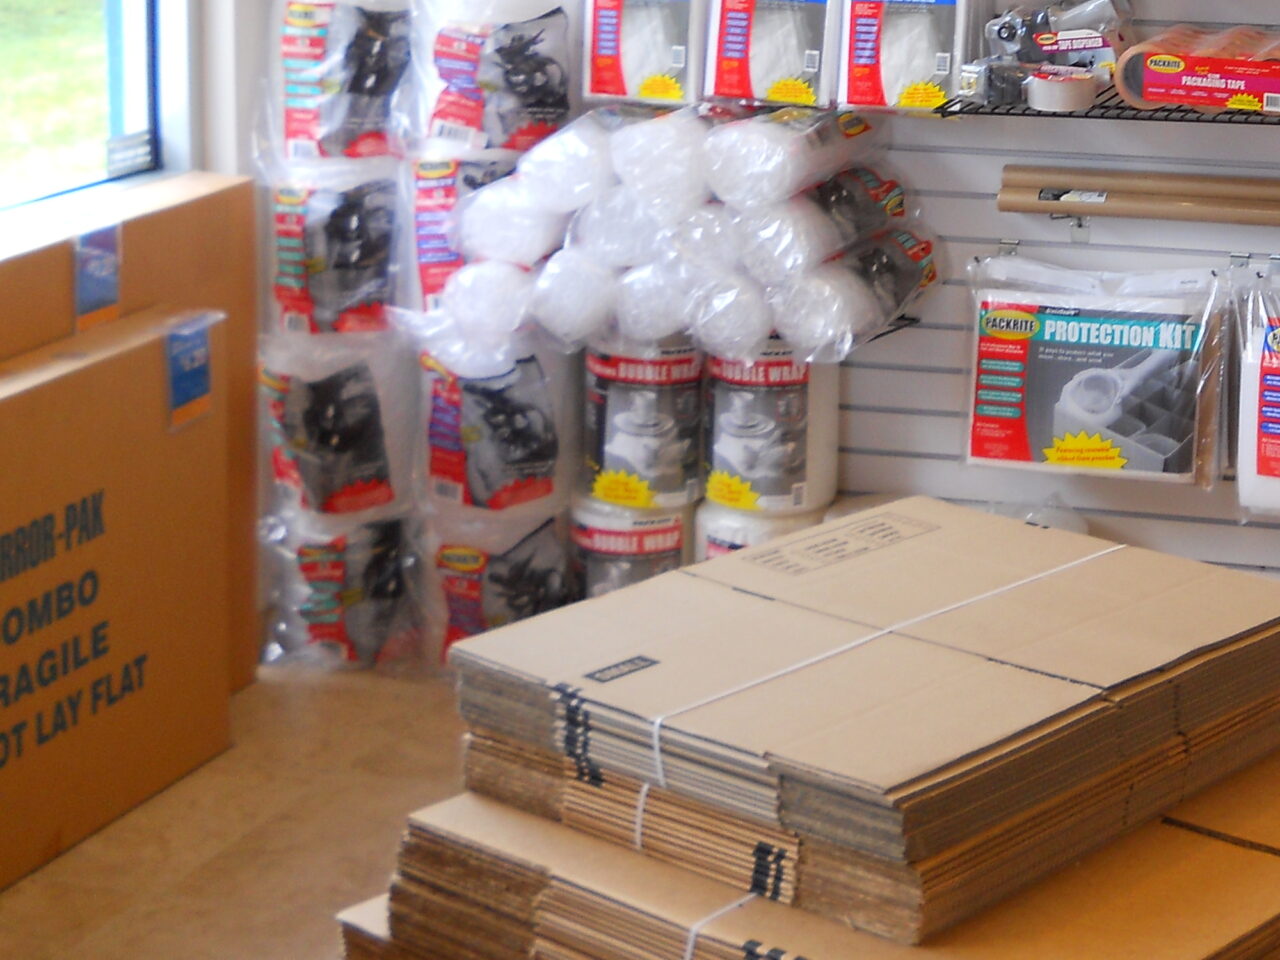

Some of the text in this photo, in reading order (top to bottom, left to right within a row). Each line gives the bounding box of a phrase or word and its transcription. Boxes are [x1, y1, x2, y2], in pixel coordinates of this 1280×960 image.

[1181, 76, 1226, 89] PACKAGING
[1227, 78, 1246, 90] TAPE
[986, 317, 1035, 332] PACKRITE
[1044, 320, 1196, 350] PROTECTION KIT
[1, 570, 99, 645] OMBO
[36, 689, 84, 746] LAY
[91, 654, 148, 715] FLAT
